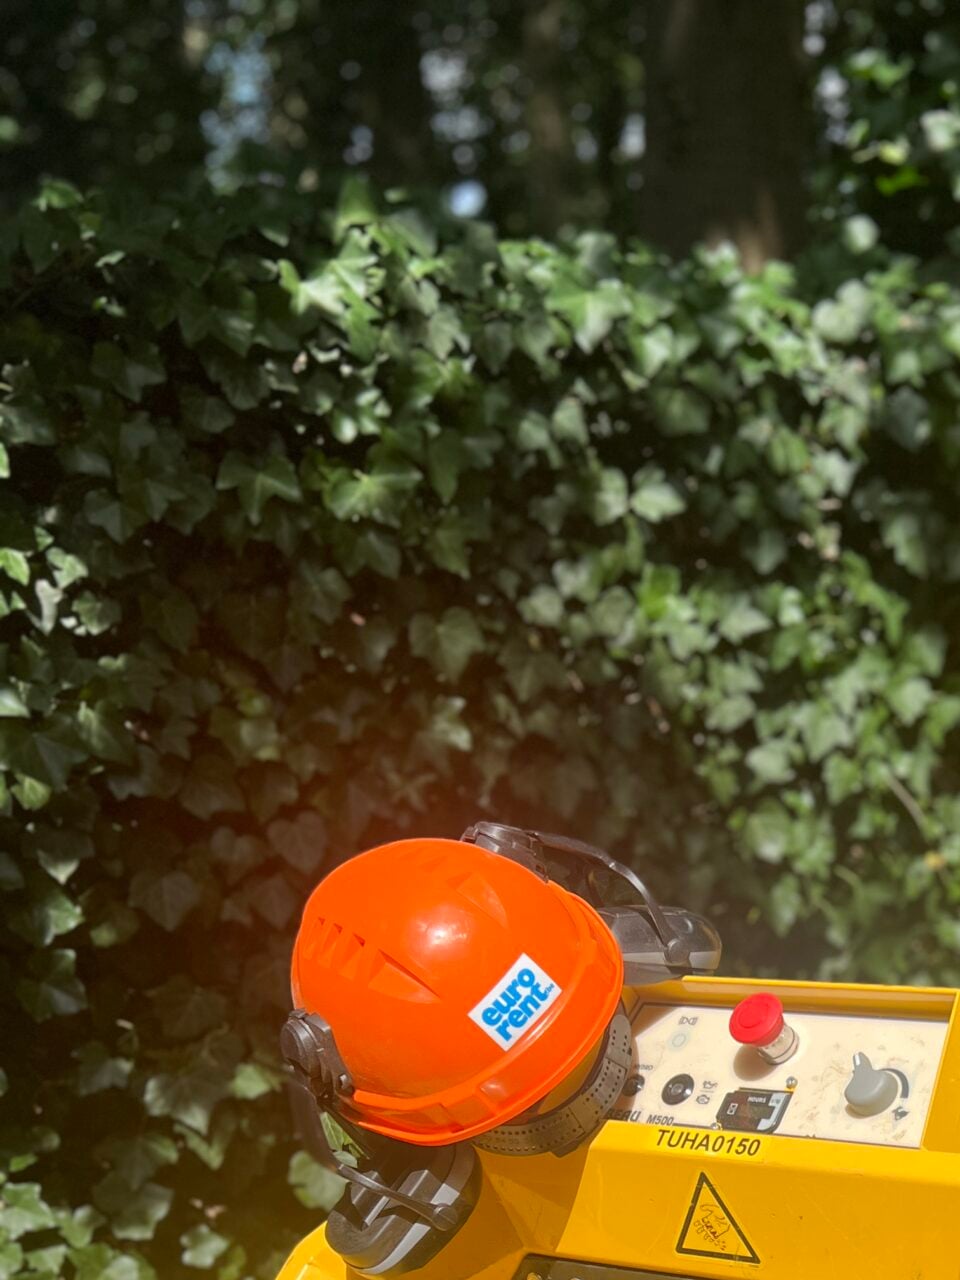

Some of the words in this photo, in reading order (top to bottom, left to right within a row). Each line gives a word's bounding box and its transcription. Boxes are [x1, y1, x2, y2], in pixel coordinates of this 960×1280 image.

[481, 968, 536, 1026] euro
[647, 1113, 675, 1126] M500
[656, 1129, 761, 1157] TUHA0150
